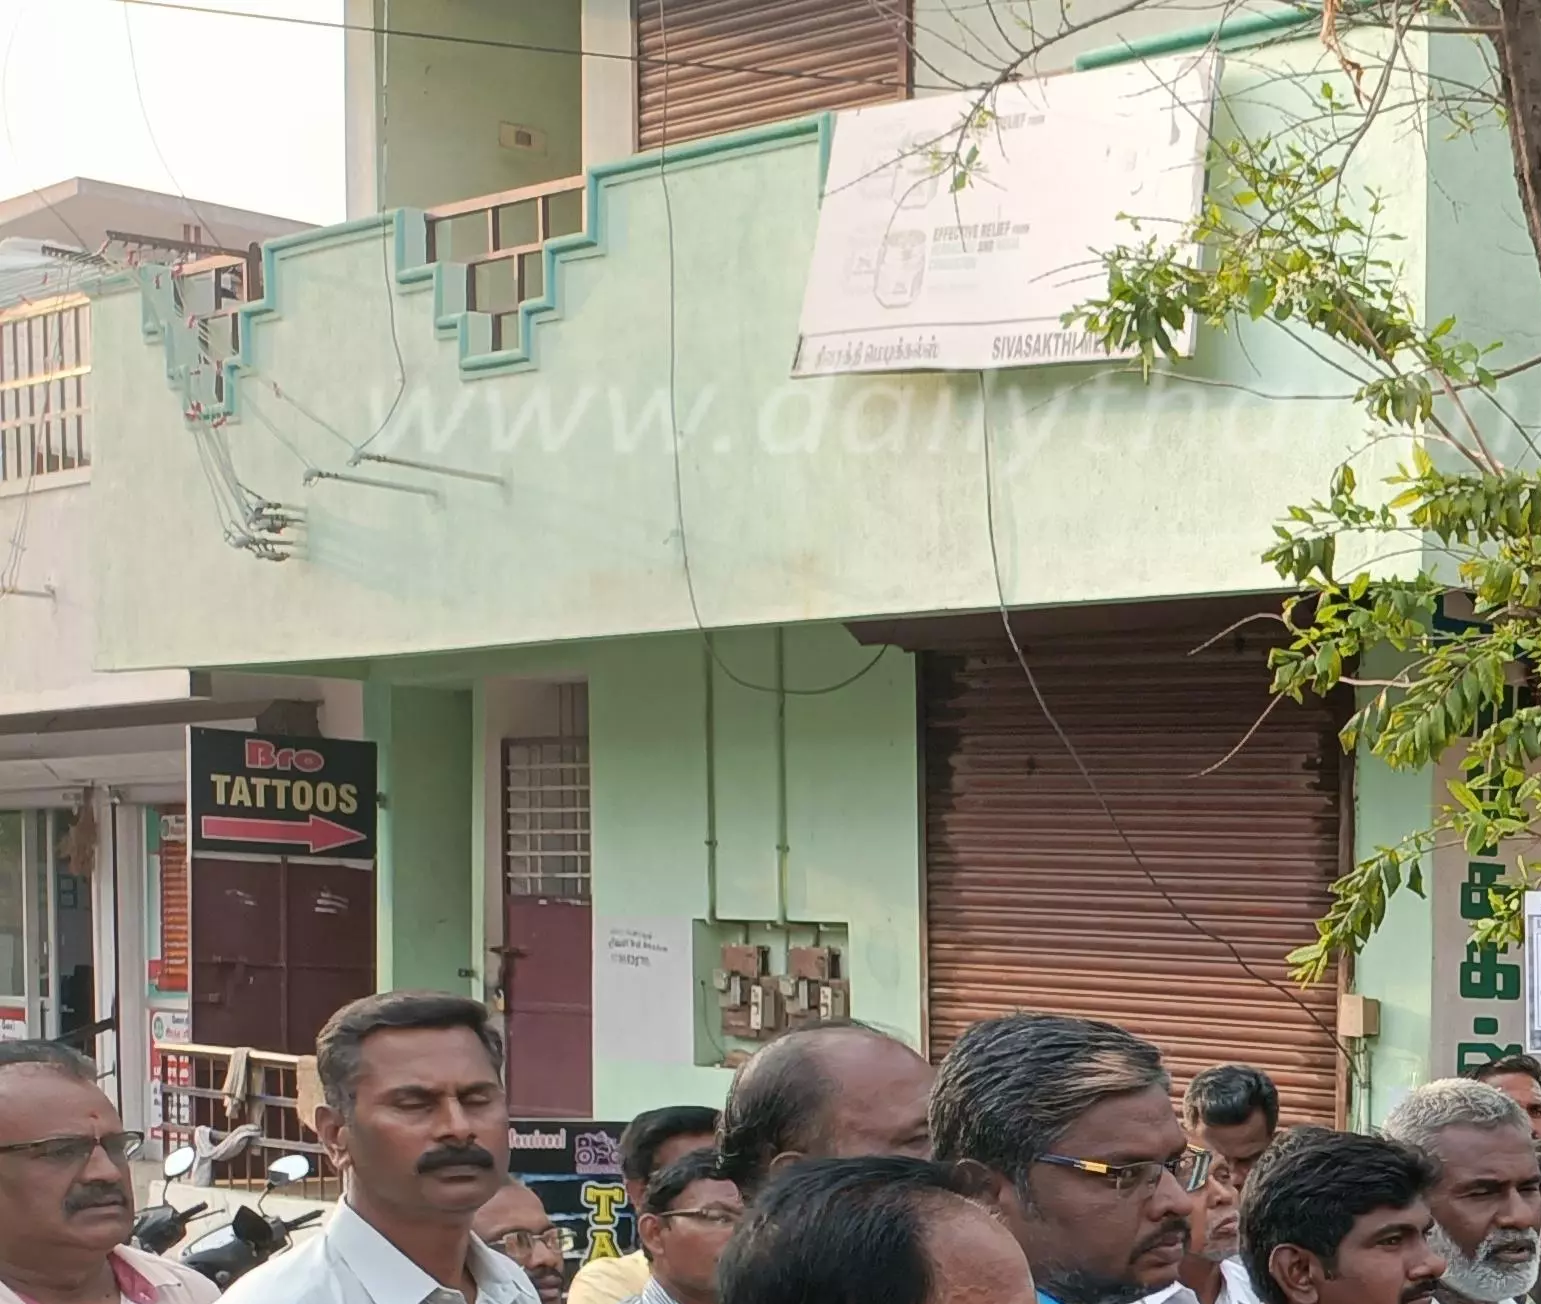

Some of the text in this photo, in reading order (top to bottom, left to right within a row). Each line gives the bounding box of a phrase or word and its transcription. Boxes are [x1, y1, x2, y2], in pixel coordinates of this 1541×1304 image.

[992, 332, 1076, 360] SIVASAKTHI
[245, 739, 324, 772] Bro
[211, 774, 358, 815] TATTOOS
